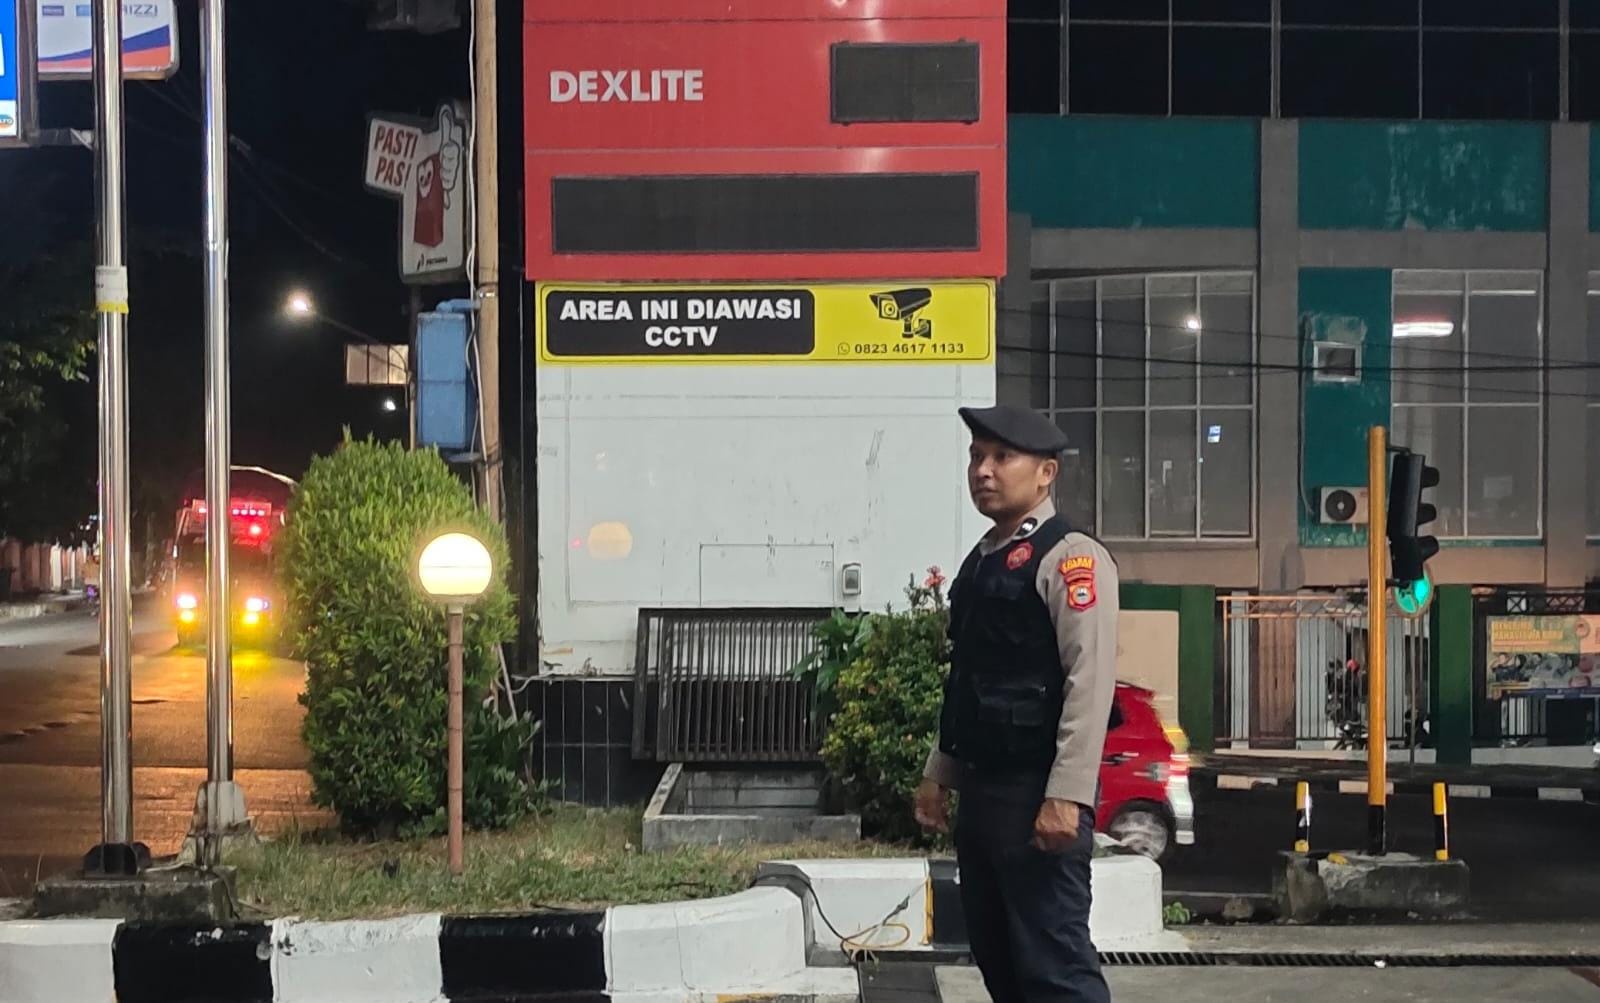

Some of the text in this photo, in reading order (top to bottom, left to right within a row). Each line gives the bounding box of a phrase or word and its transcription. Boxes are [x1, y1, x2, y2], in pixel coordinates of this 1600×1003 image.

[549, 69, 704, 102] DEXLITE
[373, 125, 419, 159] PASTI
[559, 298, 801, 320] AREA INI DIAWASI
[645, 326, 718, 347] CCTV
[854, 343, 965, 354] 0823 4617 1133
